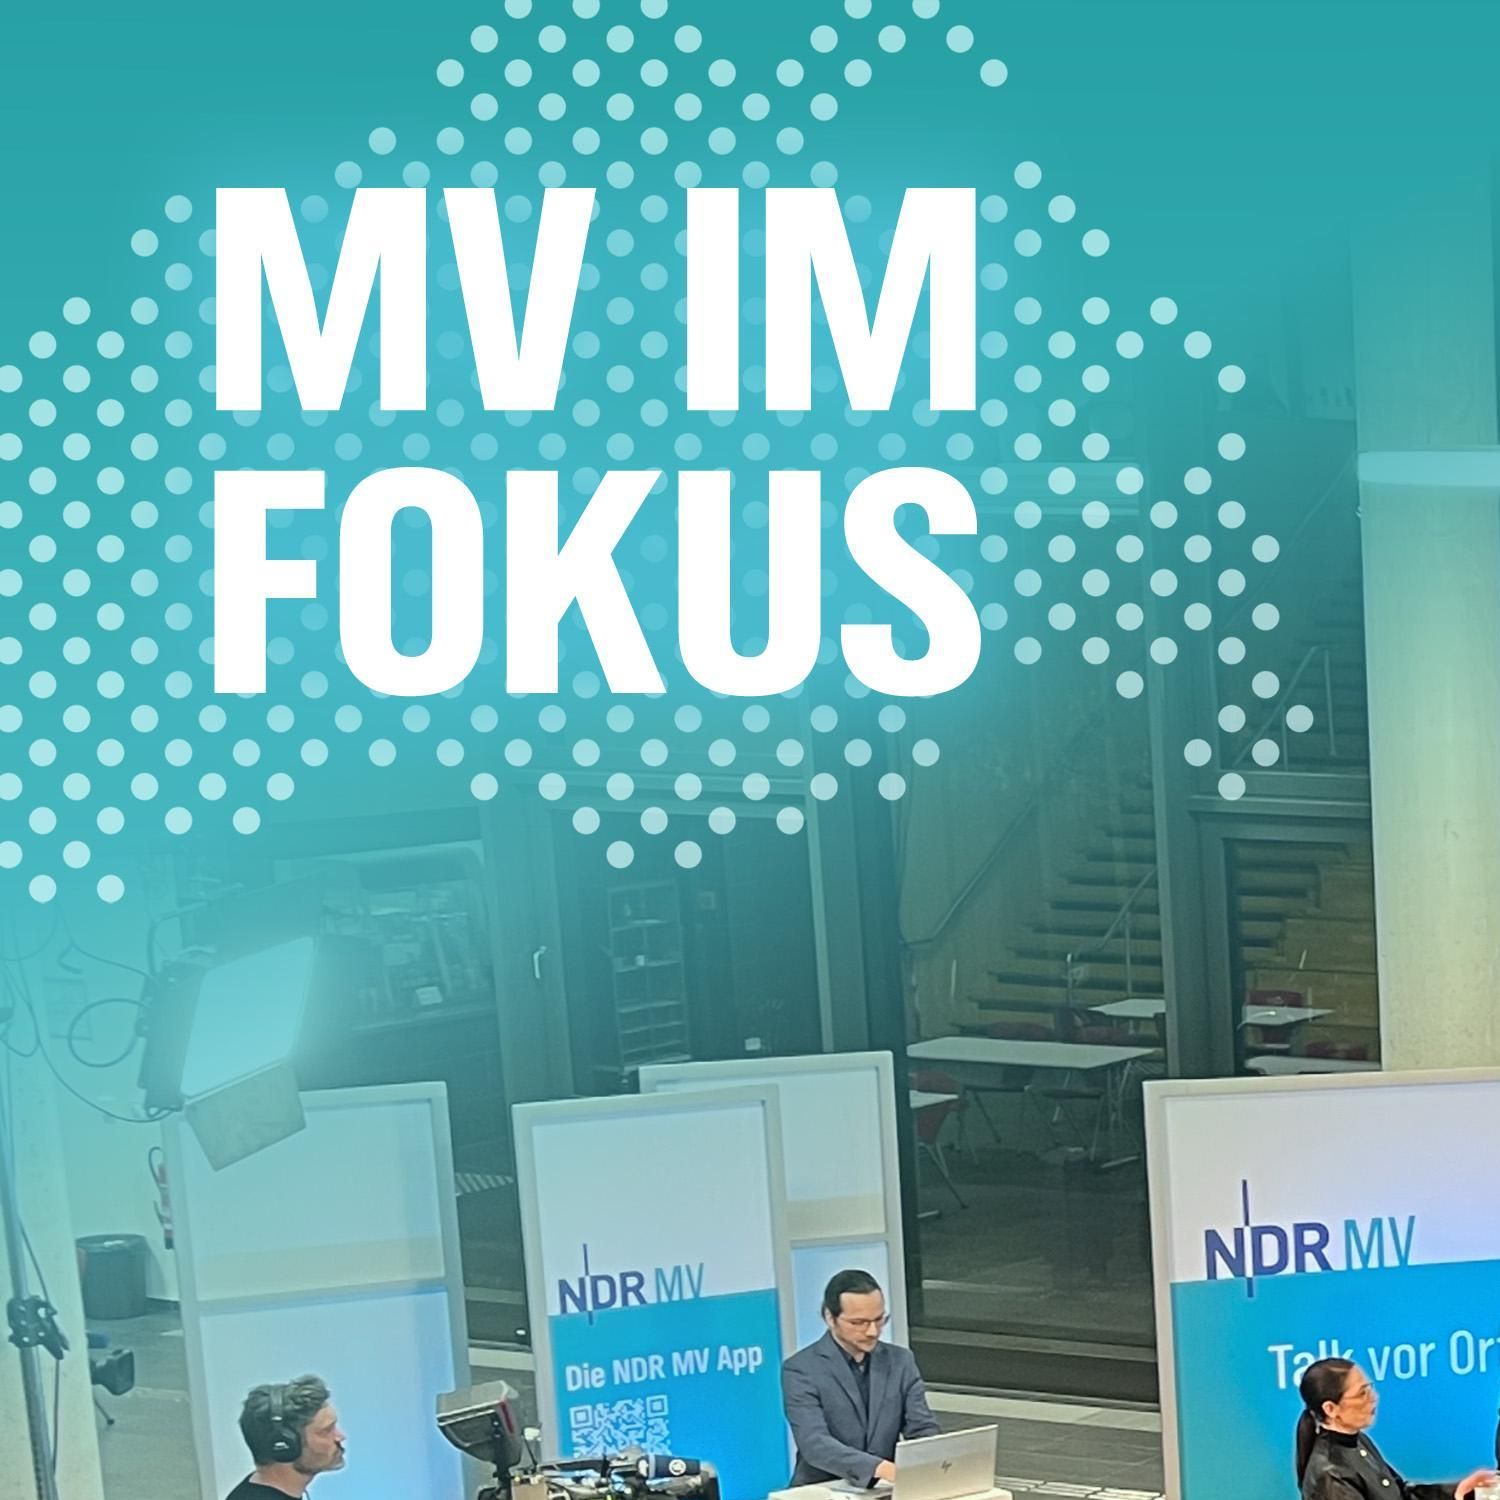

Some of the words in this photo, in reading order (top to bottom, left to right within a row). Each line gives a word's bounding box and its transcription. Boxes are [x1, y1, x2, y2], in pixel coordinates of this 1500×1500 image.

[1205, 1222, 1334, 1281] NDR
[1344, 1215, 1415, 1273] MV
[557, 1270, 648, 1315] NDR
[654, 1262, 704, 1303] MV
[564, 1362, 606, 1392] Die
[612, 1353, 666, 1385] NDR
[671, 1347, 709, 1377] MV
[717, 1345, 763, 1376] App
[1367, 1341, 1436, 1381] vor
